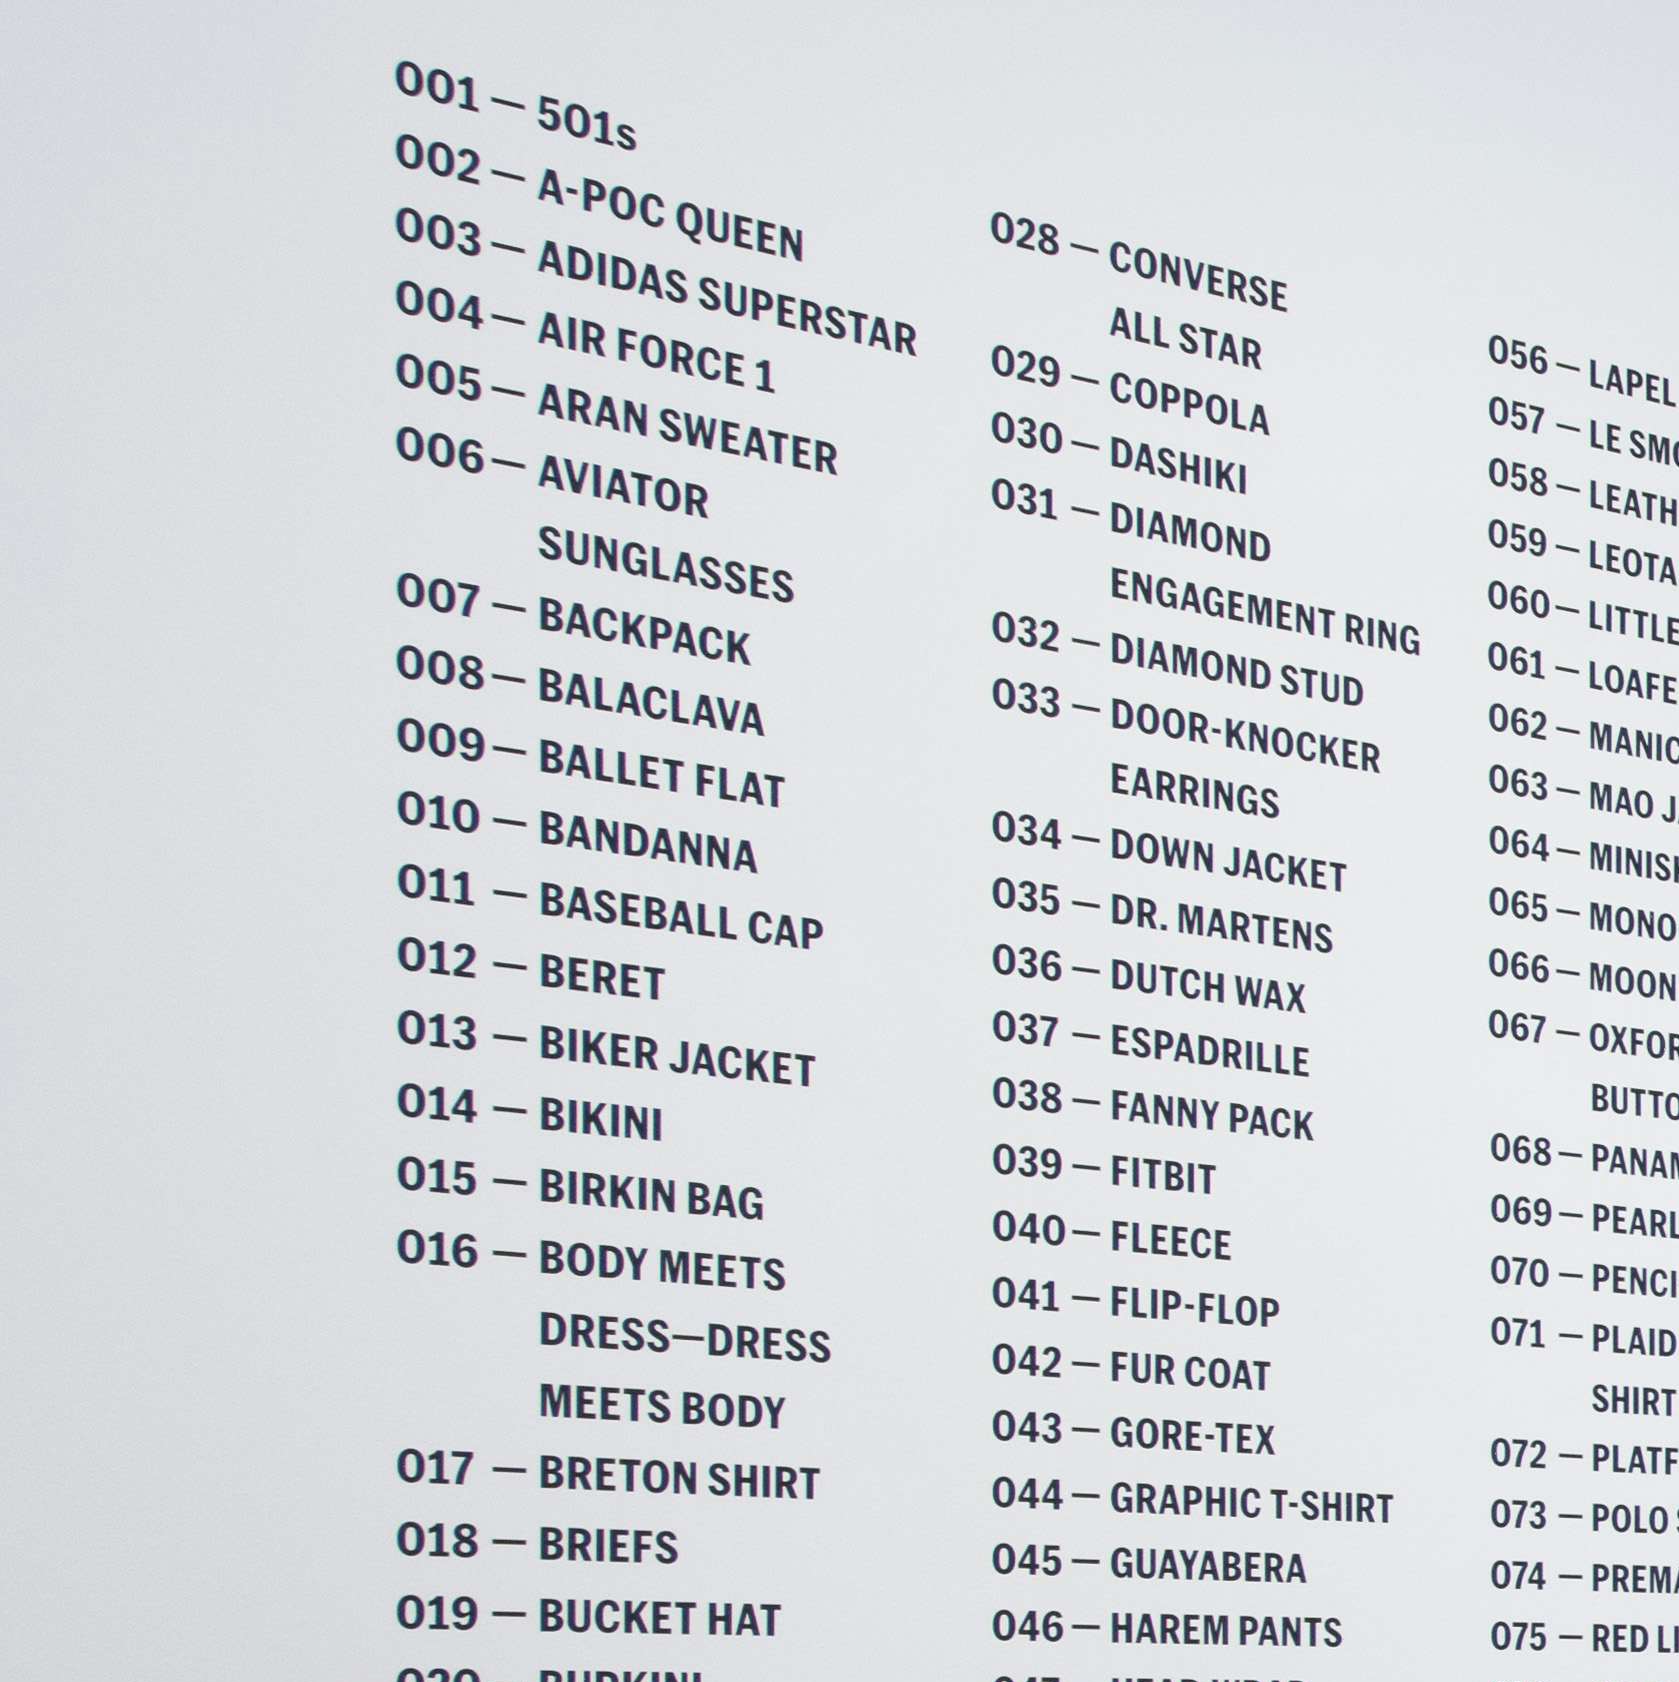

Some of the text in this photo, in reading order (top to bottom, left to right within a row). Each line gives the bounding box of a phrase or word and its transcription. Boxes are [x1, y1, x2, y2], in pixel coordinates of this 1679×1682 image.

[396, 61, 636, 150] 001 501s
[396, 134, 802, 262] 002 A-POC QUEEN
[396, 207, 916, 356] 003 ADIDAS SUPERSTAR
[991, 212, 1287, 312] 028 CONVERSE
[396, 281, 775, 393] 004 AIR FORCE 1
[1110, 307, 1261, 370] ALL STAR
[1489, 335, 1548, 374] 056
[1590, 359, 1676, 407] LAPEL
[1489, 458, 1548, 496] 058
[992, 478, 1270, 561] 031 DIAMOND
[397, 573, 751, 665] 007 BACKPACK
[1112, 567, 1419, 656] ENGAGEMENT RING
[1489, 703, 1546, 740] 062
[398, 864, 823, 949] 011 BASEBALL CAP
[993, 877, 1333, 953] 035 DR. MARTENS
[1489, 887, 1547, 922] 065
[993, 1144, 1216, 1194] 039 FITBIT
[1491, 1255, 1549, 1287] 070
[993, 1476, 1394, 1523] 044 GRAPHIC T-SHIRT
[1491, 1499, 1546, 1529] 073
[1593, 1504, 1668, 1534] POLO
[397, 1595, 781, 1636] 019 BUCKET HAT
